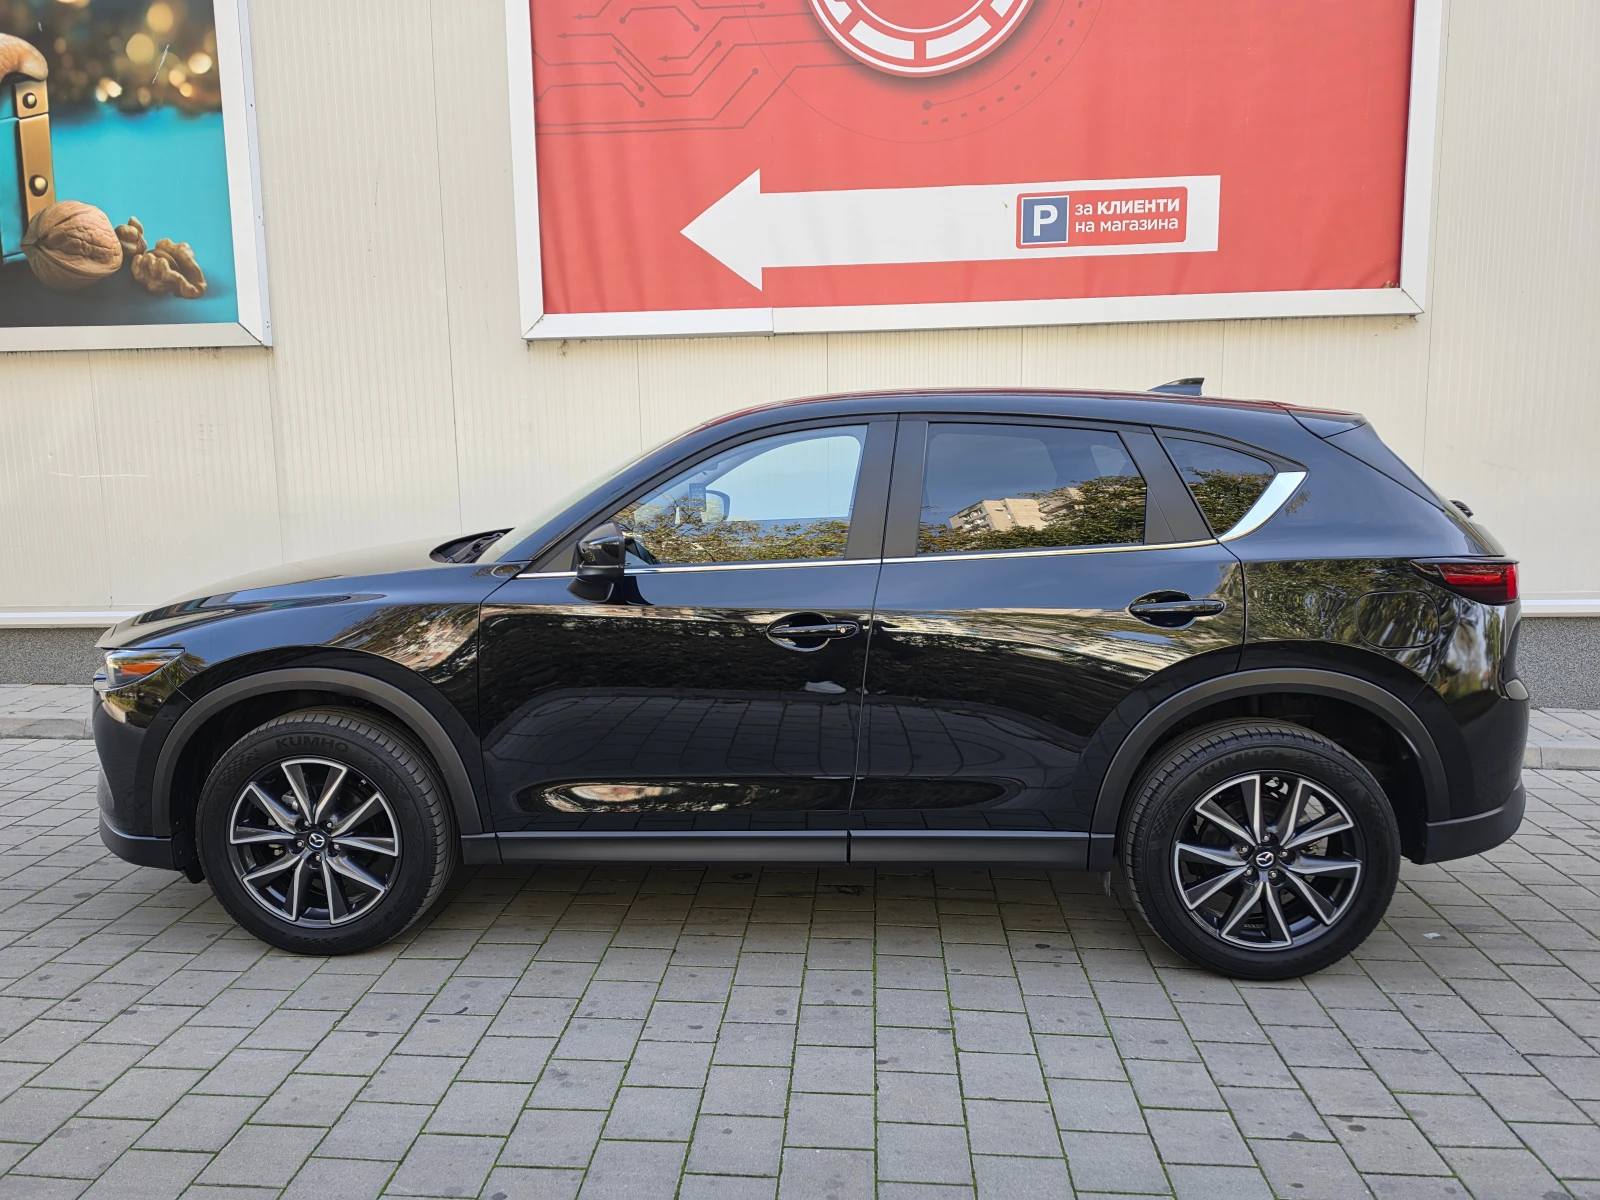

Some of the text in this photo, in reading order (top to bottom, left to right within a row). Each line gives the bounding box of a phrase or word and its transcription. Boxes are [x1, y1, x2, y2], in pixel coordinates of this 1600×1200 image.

[1074, 198, 1180, 216] за КЛИЕНТИ
[1033, 204, 1058, 237] P
[1075, 217, 1179, 233] на магазина
[275, 735, 349, 753] KUMHO
[1196, 749, 1276, 782] KUMHO
